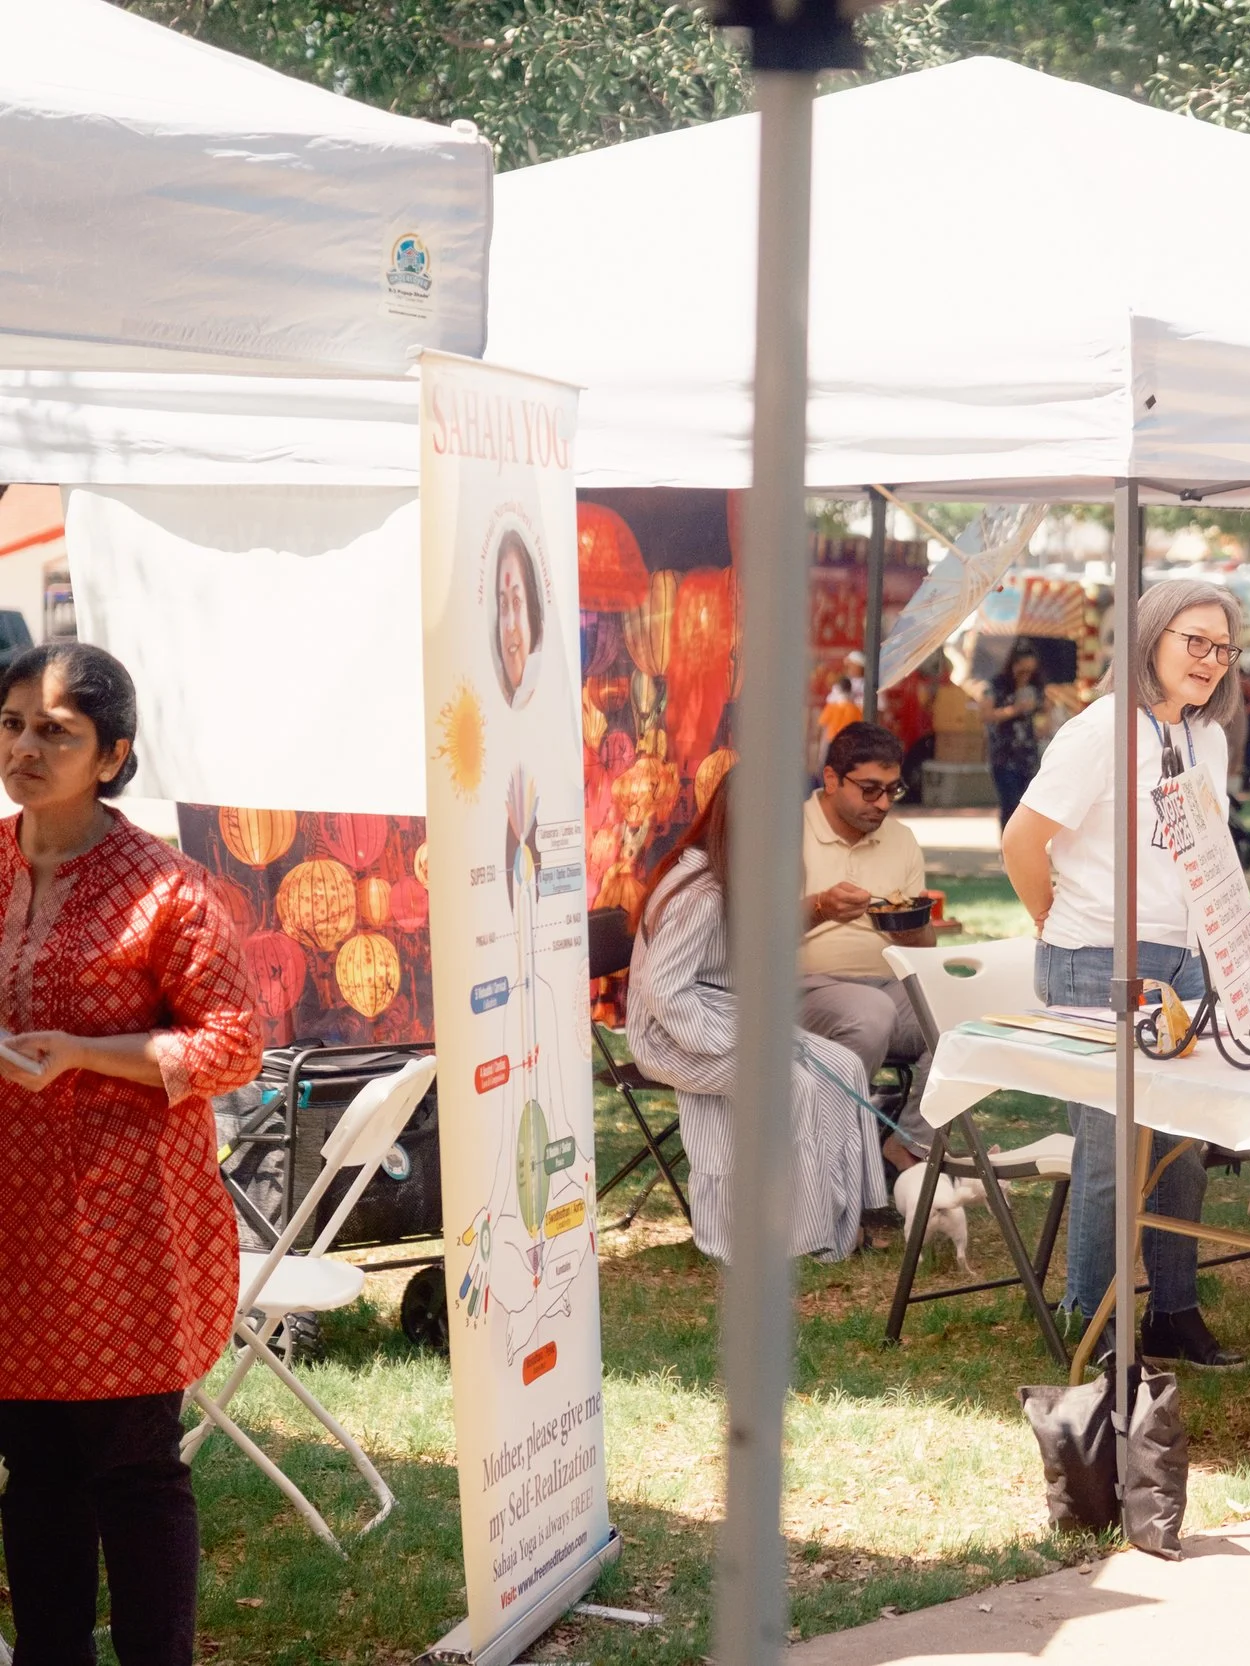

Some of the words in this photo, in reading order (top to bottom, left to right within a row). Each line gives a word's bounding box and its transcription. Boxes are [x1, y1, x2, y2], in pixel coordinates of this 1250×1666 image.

[432, 382, 519, 477] SAHAJA
[521, 399, 570, 471] YOG
[1157, 792, 1187, 825] VOTE
[482, 1440, 525, 1492] Mother,
[526, 1420, 558, 1471] please
[560, 1400, 583, 1447] give
[585, 1391, 601, 1421] me
[489, 1507, 506, 1545] my
[508, 1443, 597, 1527] Self-Realization
[493, 1546, 518, 1582] Sahaja
[519, 1536, 537, 1561] Yoga
[538, 1526, 545, 1547] is
[545, 1509, 570, 1541] always
[571, 1486, 594, 1521] FREE!
[501, 1585, 517, 1609] Visit:
[517, 1531, 588, 1597] www.freemeditation.com
